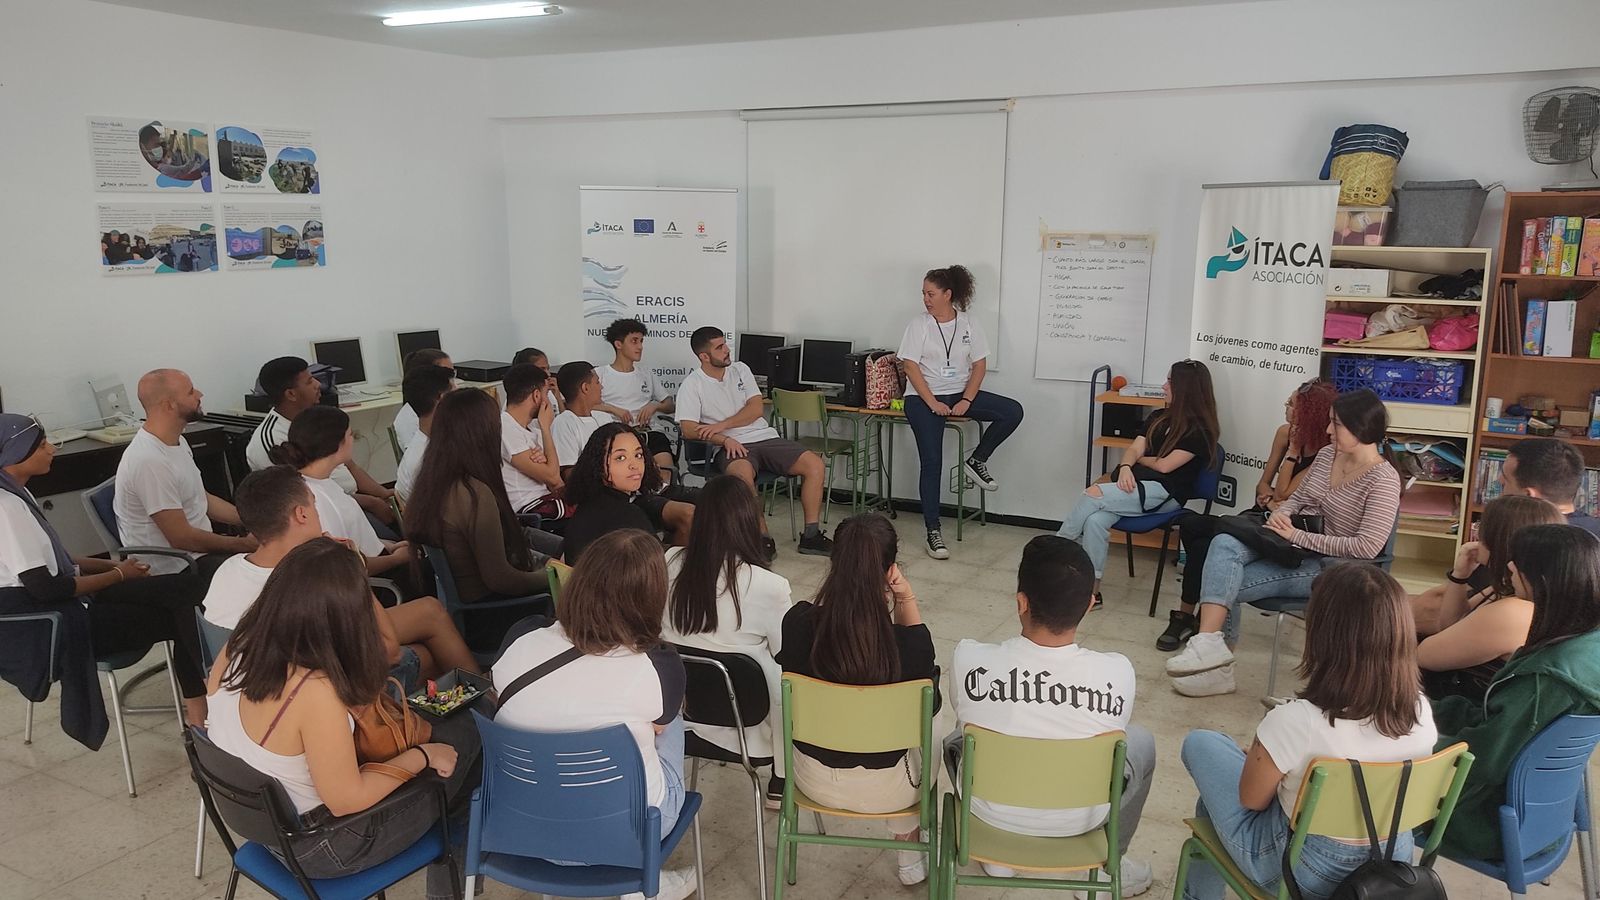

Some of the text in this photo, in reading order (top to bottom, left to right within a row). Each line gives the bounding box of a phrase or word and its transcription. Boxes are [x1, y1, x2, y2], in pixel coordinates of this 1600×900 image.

[602, 223, 624, 232] ÍTACA
[1253, 236, 1324, 268] ÍTACA
[1252, 270, 1324, 286] ASOCIACIÓN
[636, 296, 685, 307] ERACIS
[634, 312, 689, 324] ALMERÍA
[1196, 332, 1320, 357] Los jóvenes como agentes
[1209, 352, 1306, 374] de cambio, de futuro.
[652, 367, 686, 377] egional
[964, 666, 1125, 717] California
